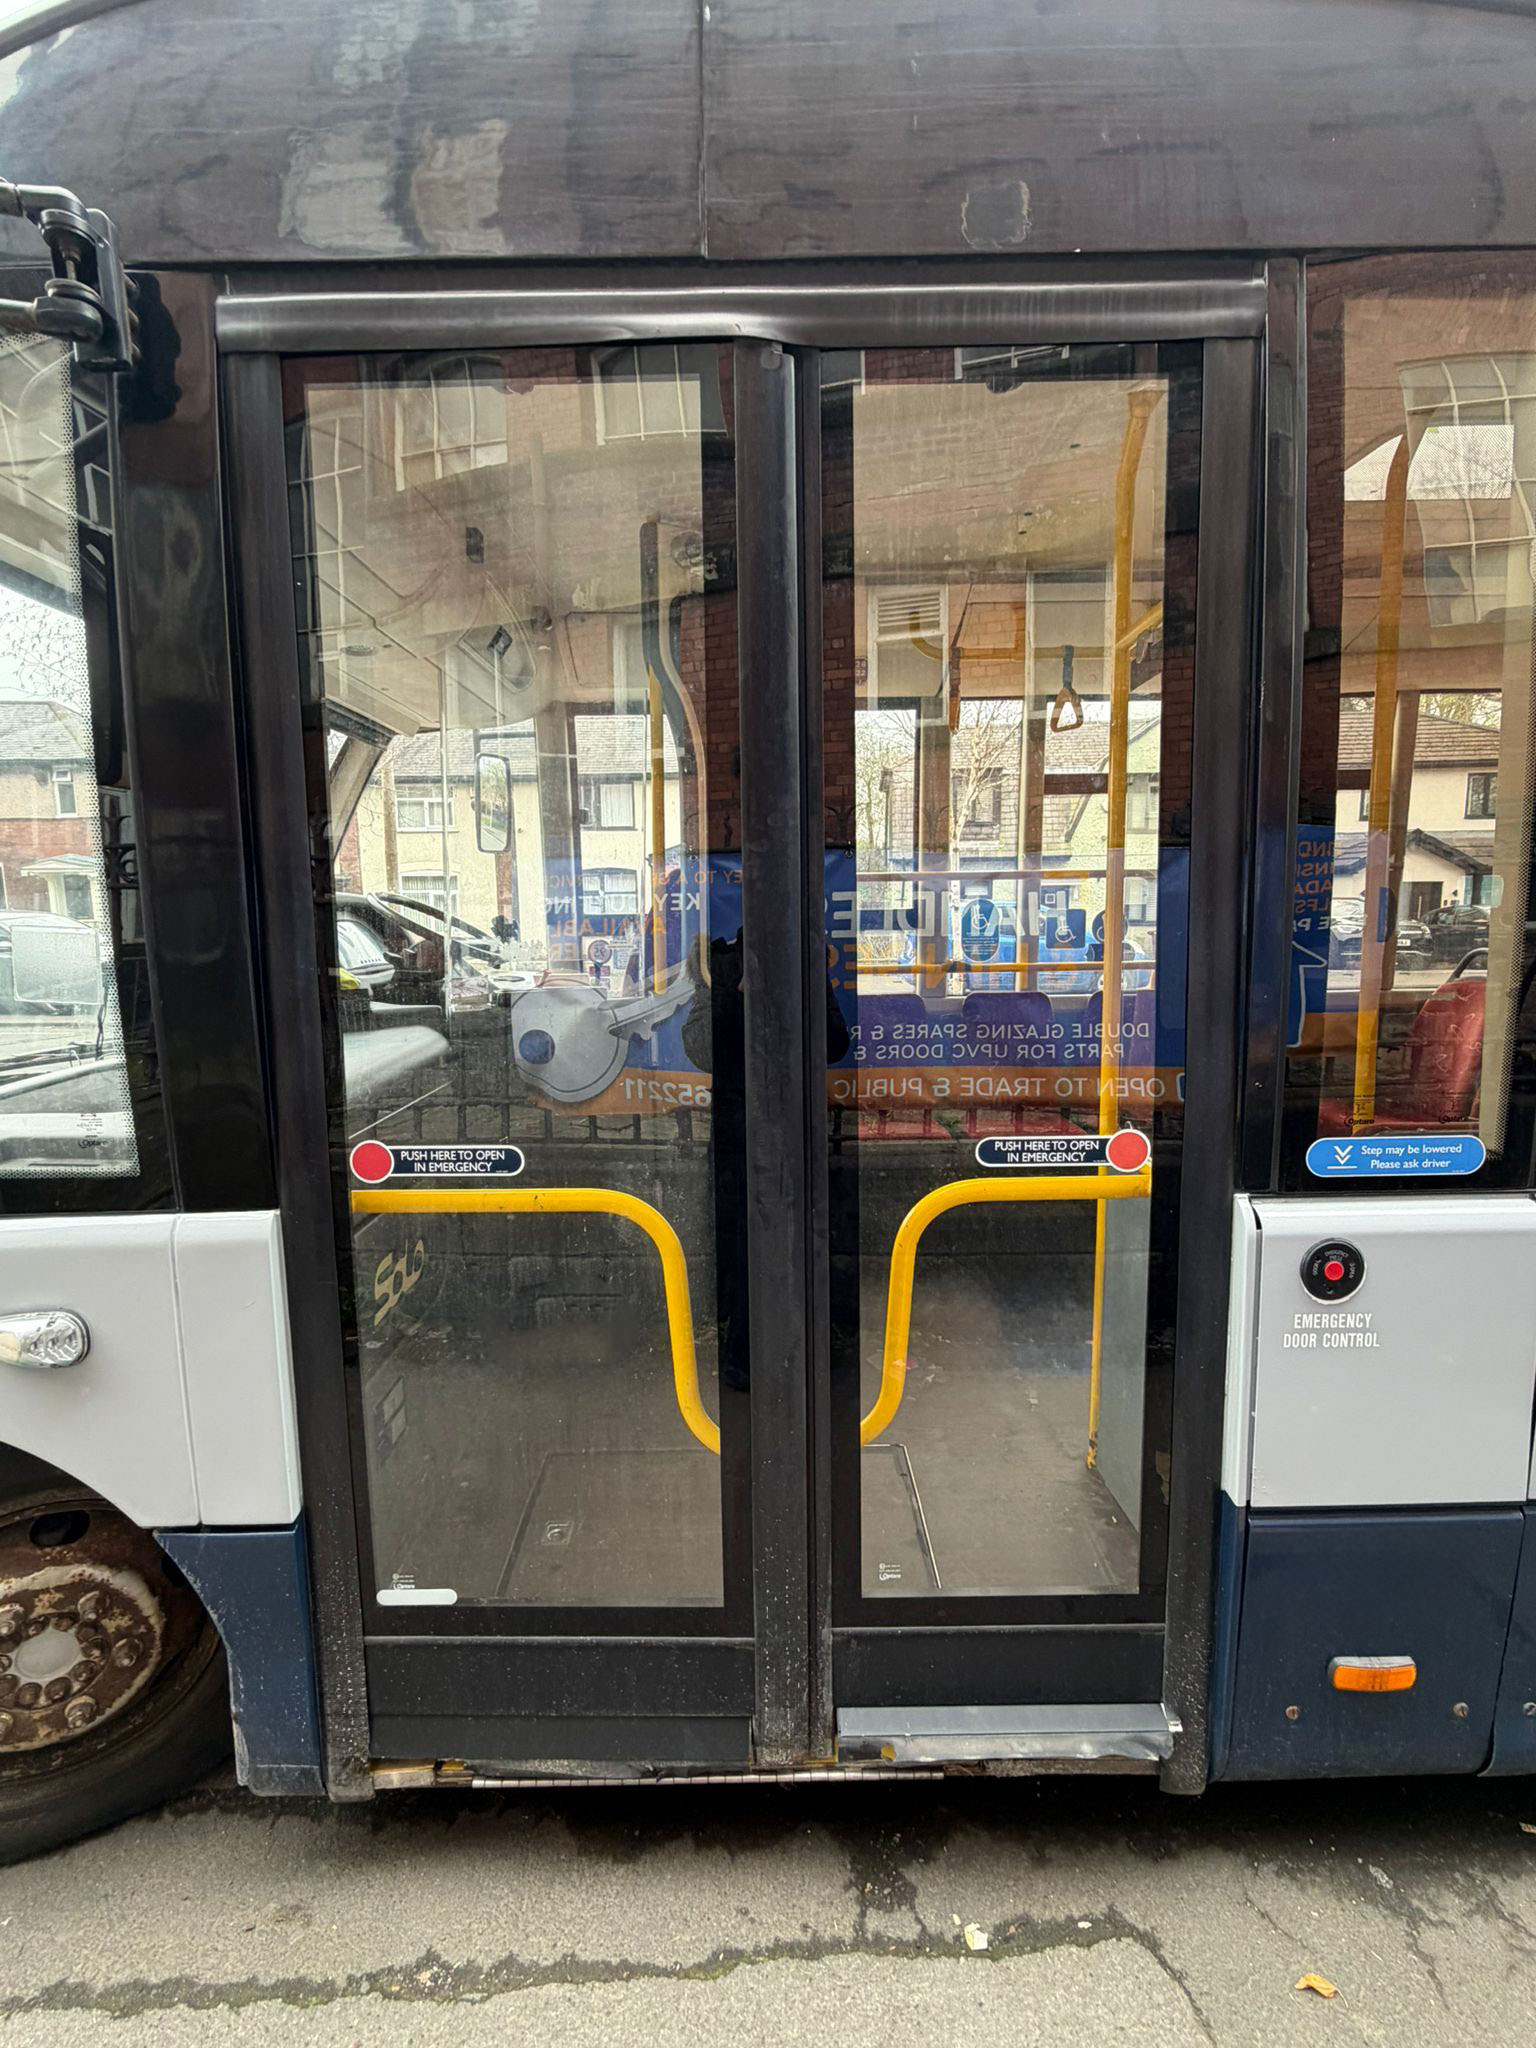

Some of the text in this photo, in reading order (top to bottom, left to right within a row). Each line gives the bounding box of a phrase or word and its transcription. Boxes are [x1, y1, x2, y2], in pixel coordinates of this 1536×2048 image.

[994, 1140, 1100, 1151] PUSH HERE TO OPEN
[1361, 1143, 1463, 1157] Step may be lowered
[400, 1150, 505, 1161] PUSH HERE TO OPEN
[1007, 1152, 1087, 1163] IN EMERGENCY
[414, 1162, 426, 1172] IN
[428, 1161, 493, 1172] EMERGENCY
[1370, 1157, 1452, 1169] Please ask driver
[1293, 1313, 1373, 1329] EMERGENCY
[1283, 1332, 1380, 1349] DOOR CONTROL
